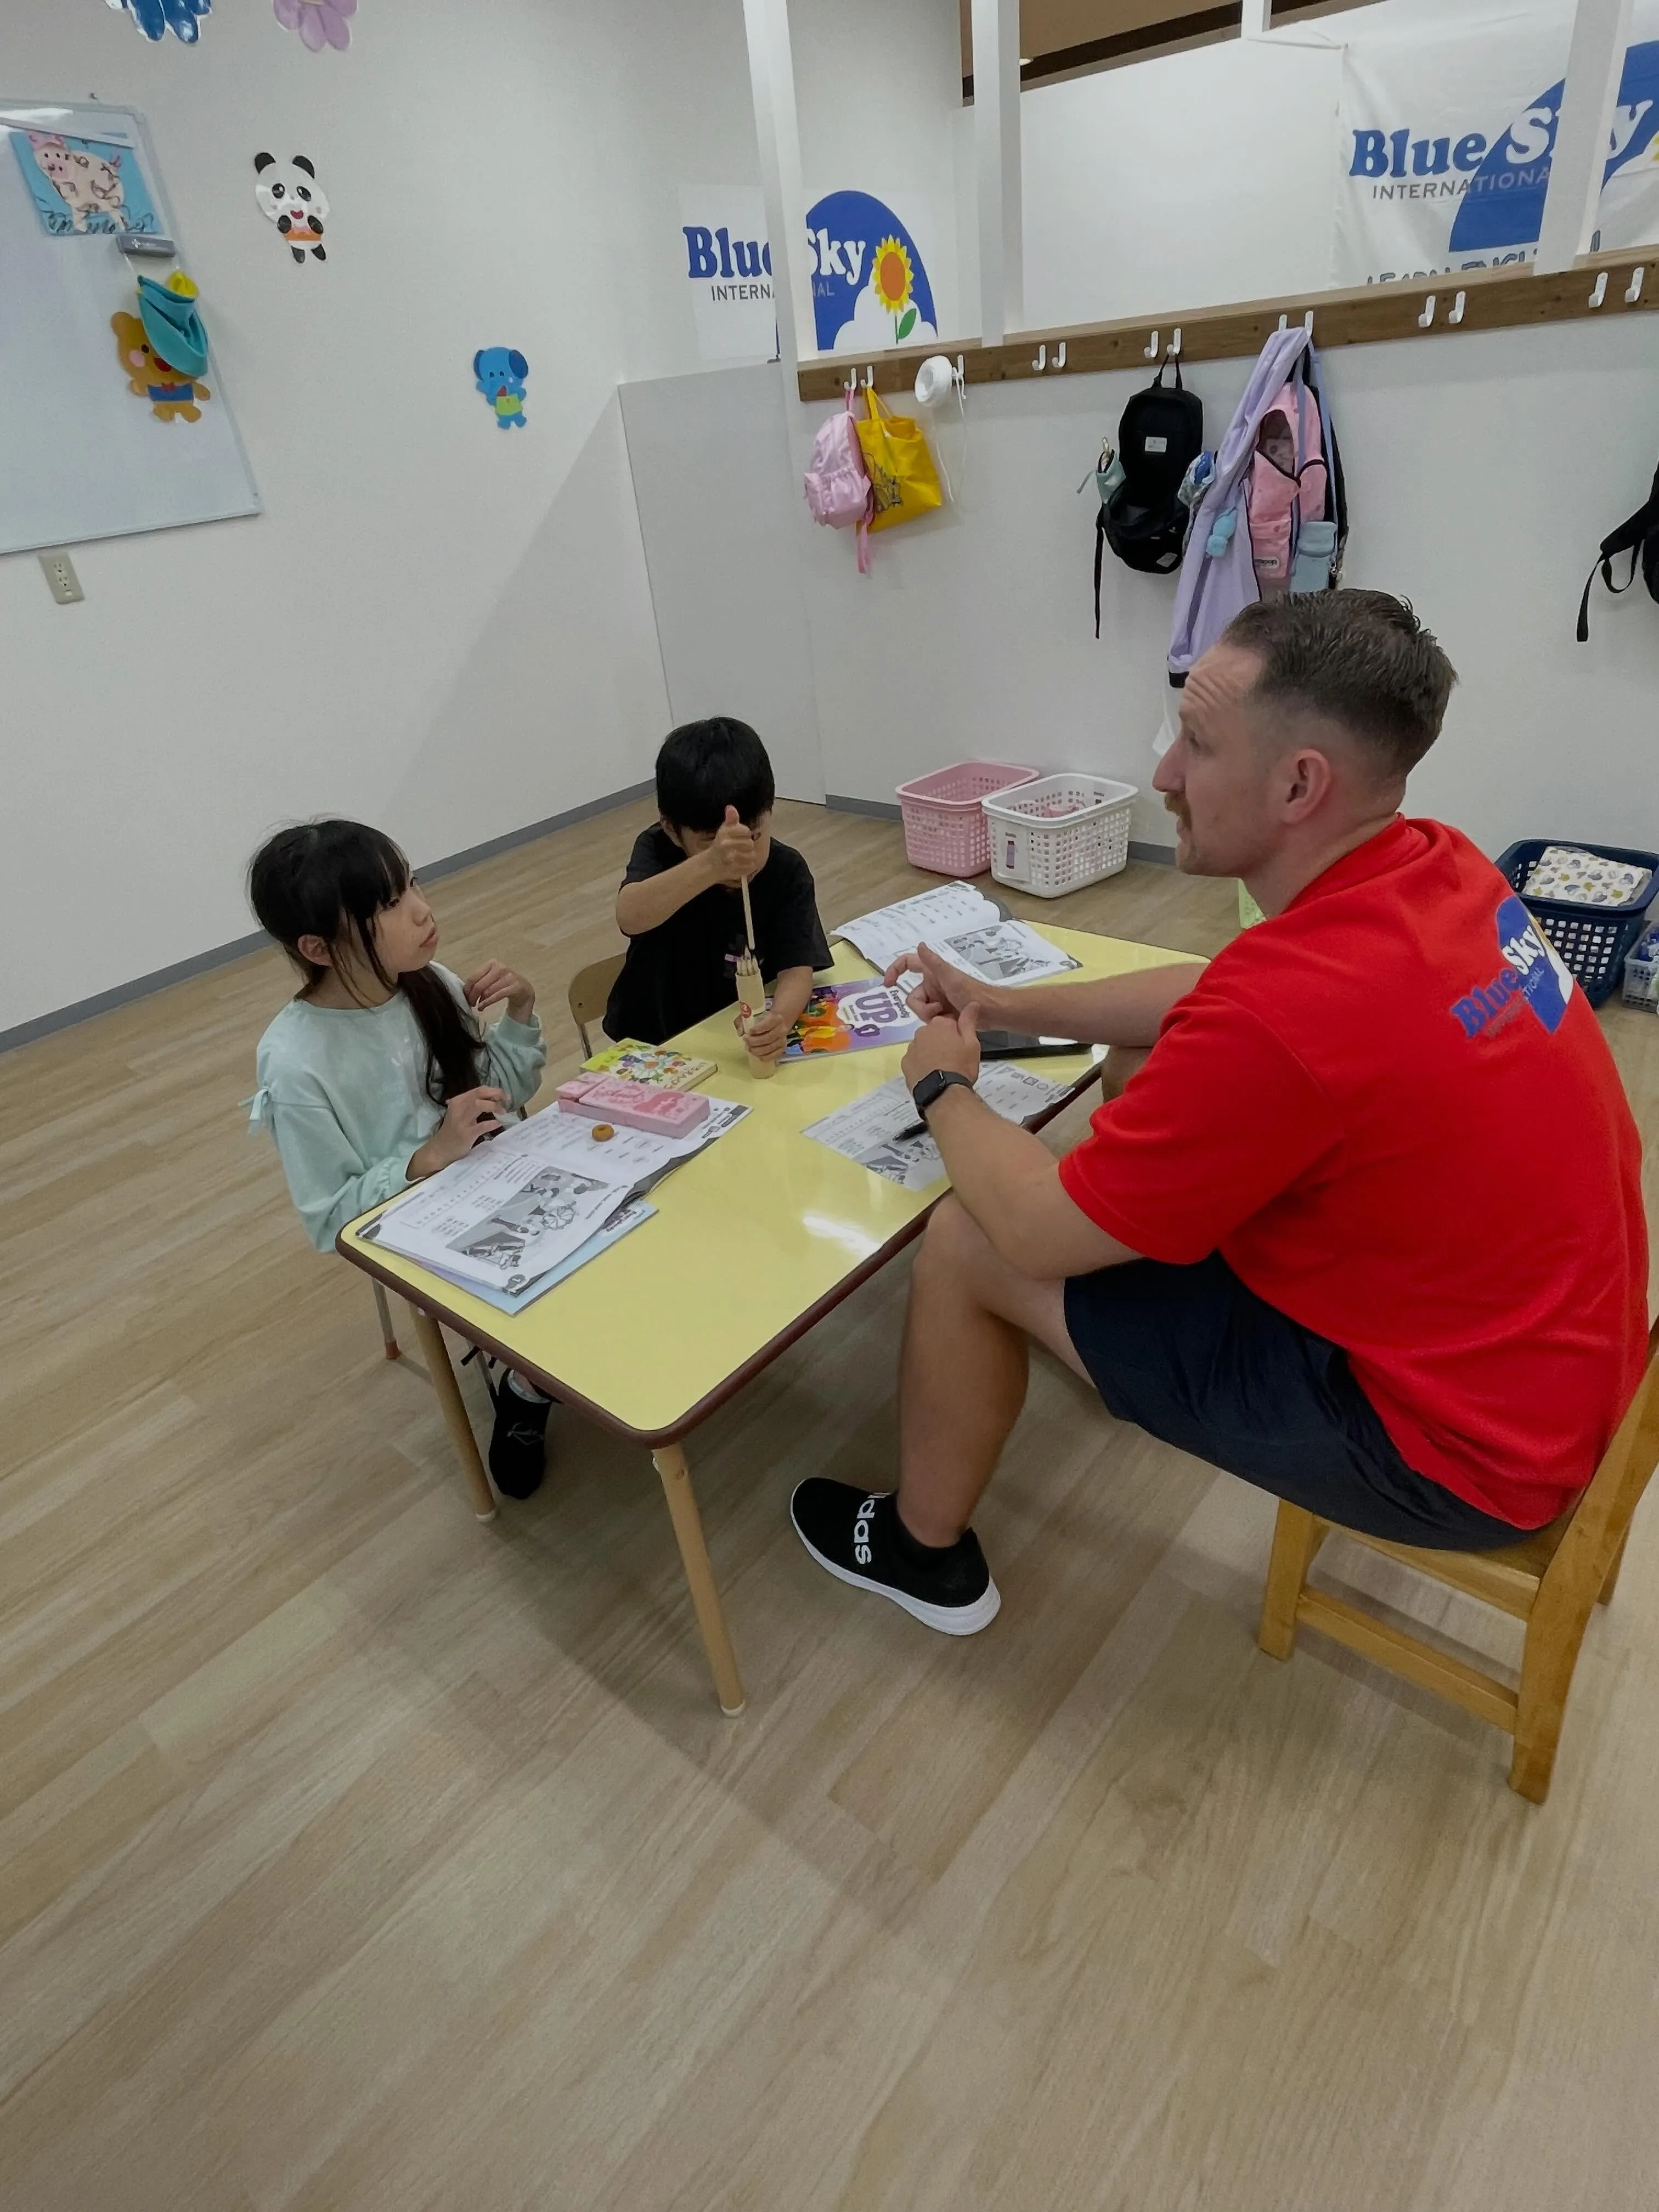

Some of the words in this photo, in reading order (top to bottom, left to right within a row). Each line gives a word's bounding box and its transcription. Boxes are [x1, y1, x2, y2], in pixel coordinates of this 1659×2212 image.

[1348, 127, 1487, 179] Blue
[1505, 99, 1653, 165] Sy
[1372, 166, 1550, 200] INTERNATIONA
[855, 991, 898, 1023] UP
[889, 989, 910, 1019] Everybody
[1449, 967, 1519, 1039] Blue
